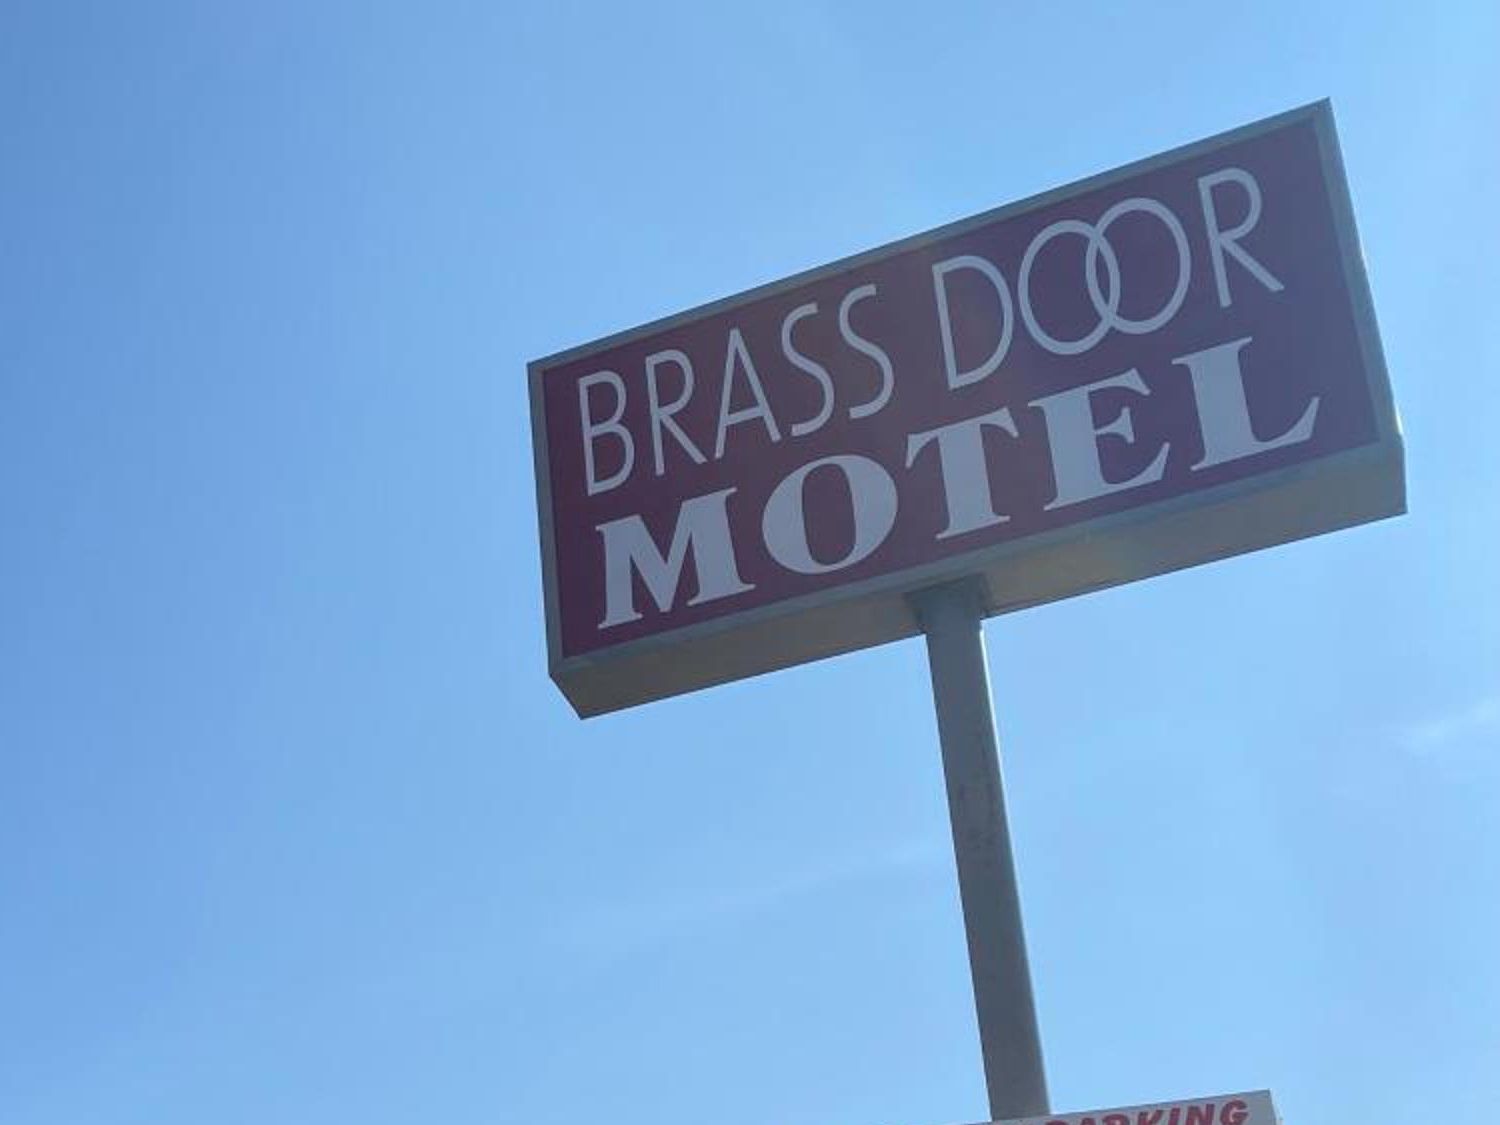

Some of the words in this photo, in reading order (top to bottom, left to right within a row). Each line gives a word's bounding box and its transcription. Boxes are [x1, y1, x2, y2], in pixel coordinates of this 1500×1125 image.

[578, 284, 896, 497] BRASS
[933, 167, 1284, 390] DOOR
[596, 336, 1320, 630] MOTEL
